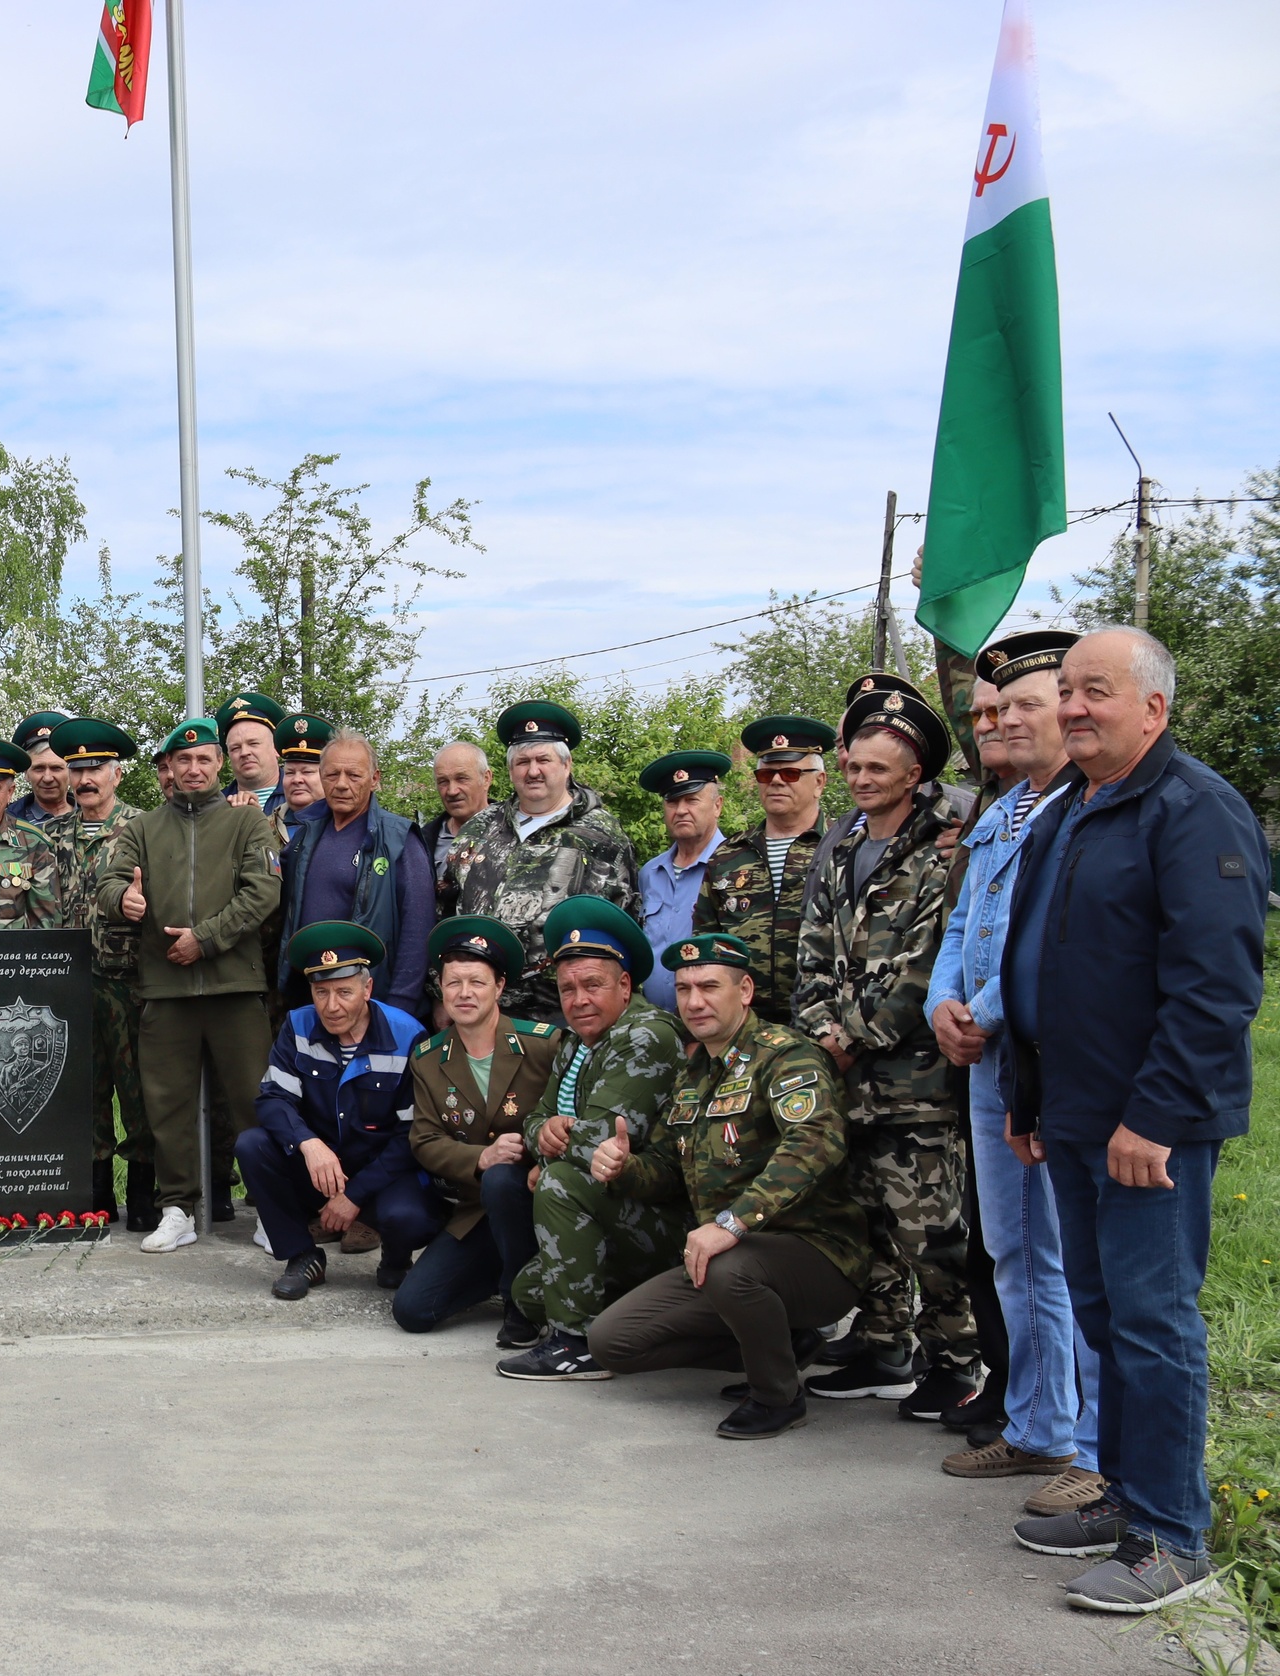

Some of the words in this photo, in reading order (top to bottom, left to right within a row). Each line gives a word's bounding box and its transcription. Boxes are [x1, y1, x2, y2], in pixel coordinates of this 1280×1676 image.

[1000, 653, 1058, 679] ПОГРАНВОЙСК
[25, 952, 38, 960] на
[41, 952, 73, 963] славу,
[19, 964, 70, 979] державы!
[6, 1166, 62, 1179] поколений
[27, 1181, 70, 1195] района!
